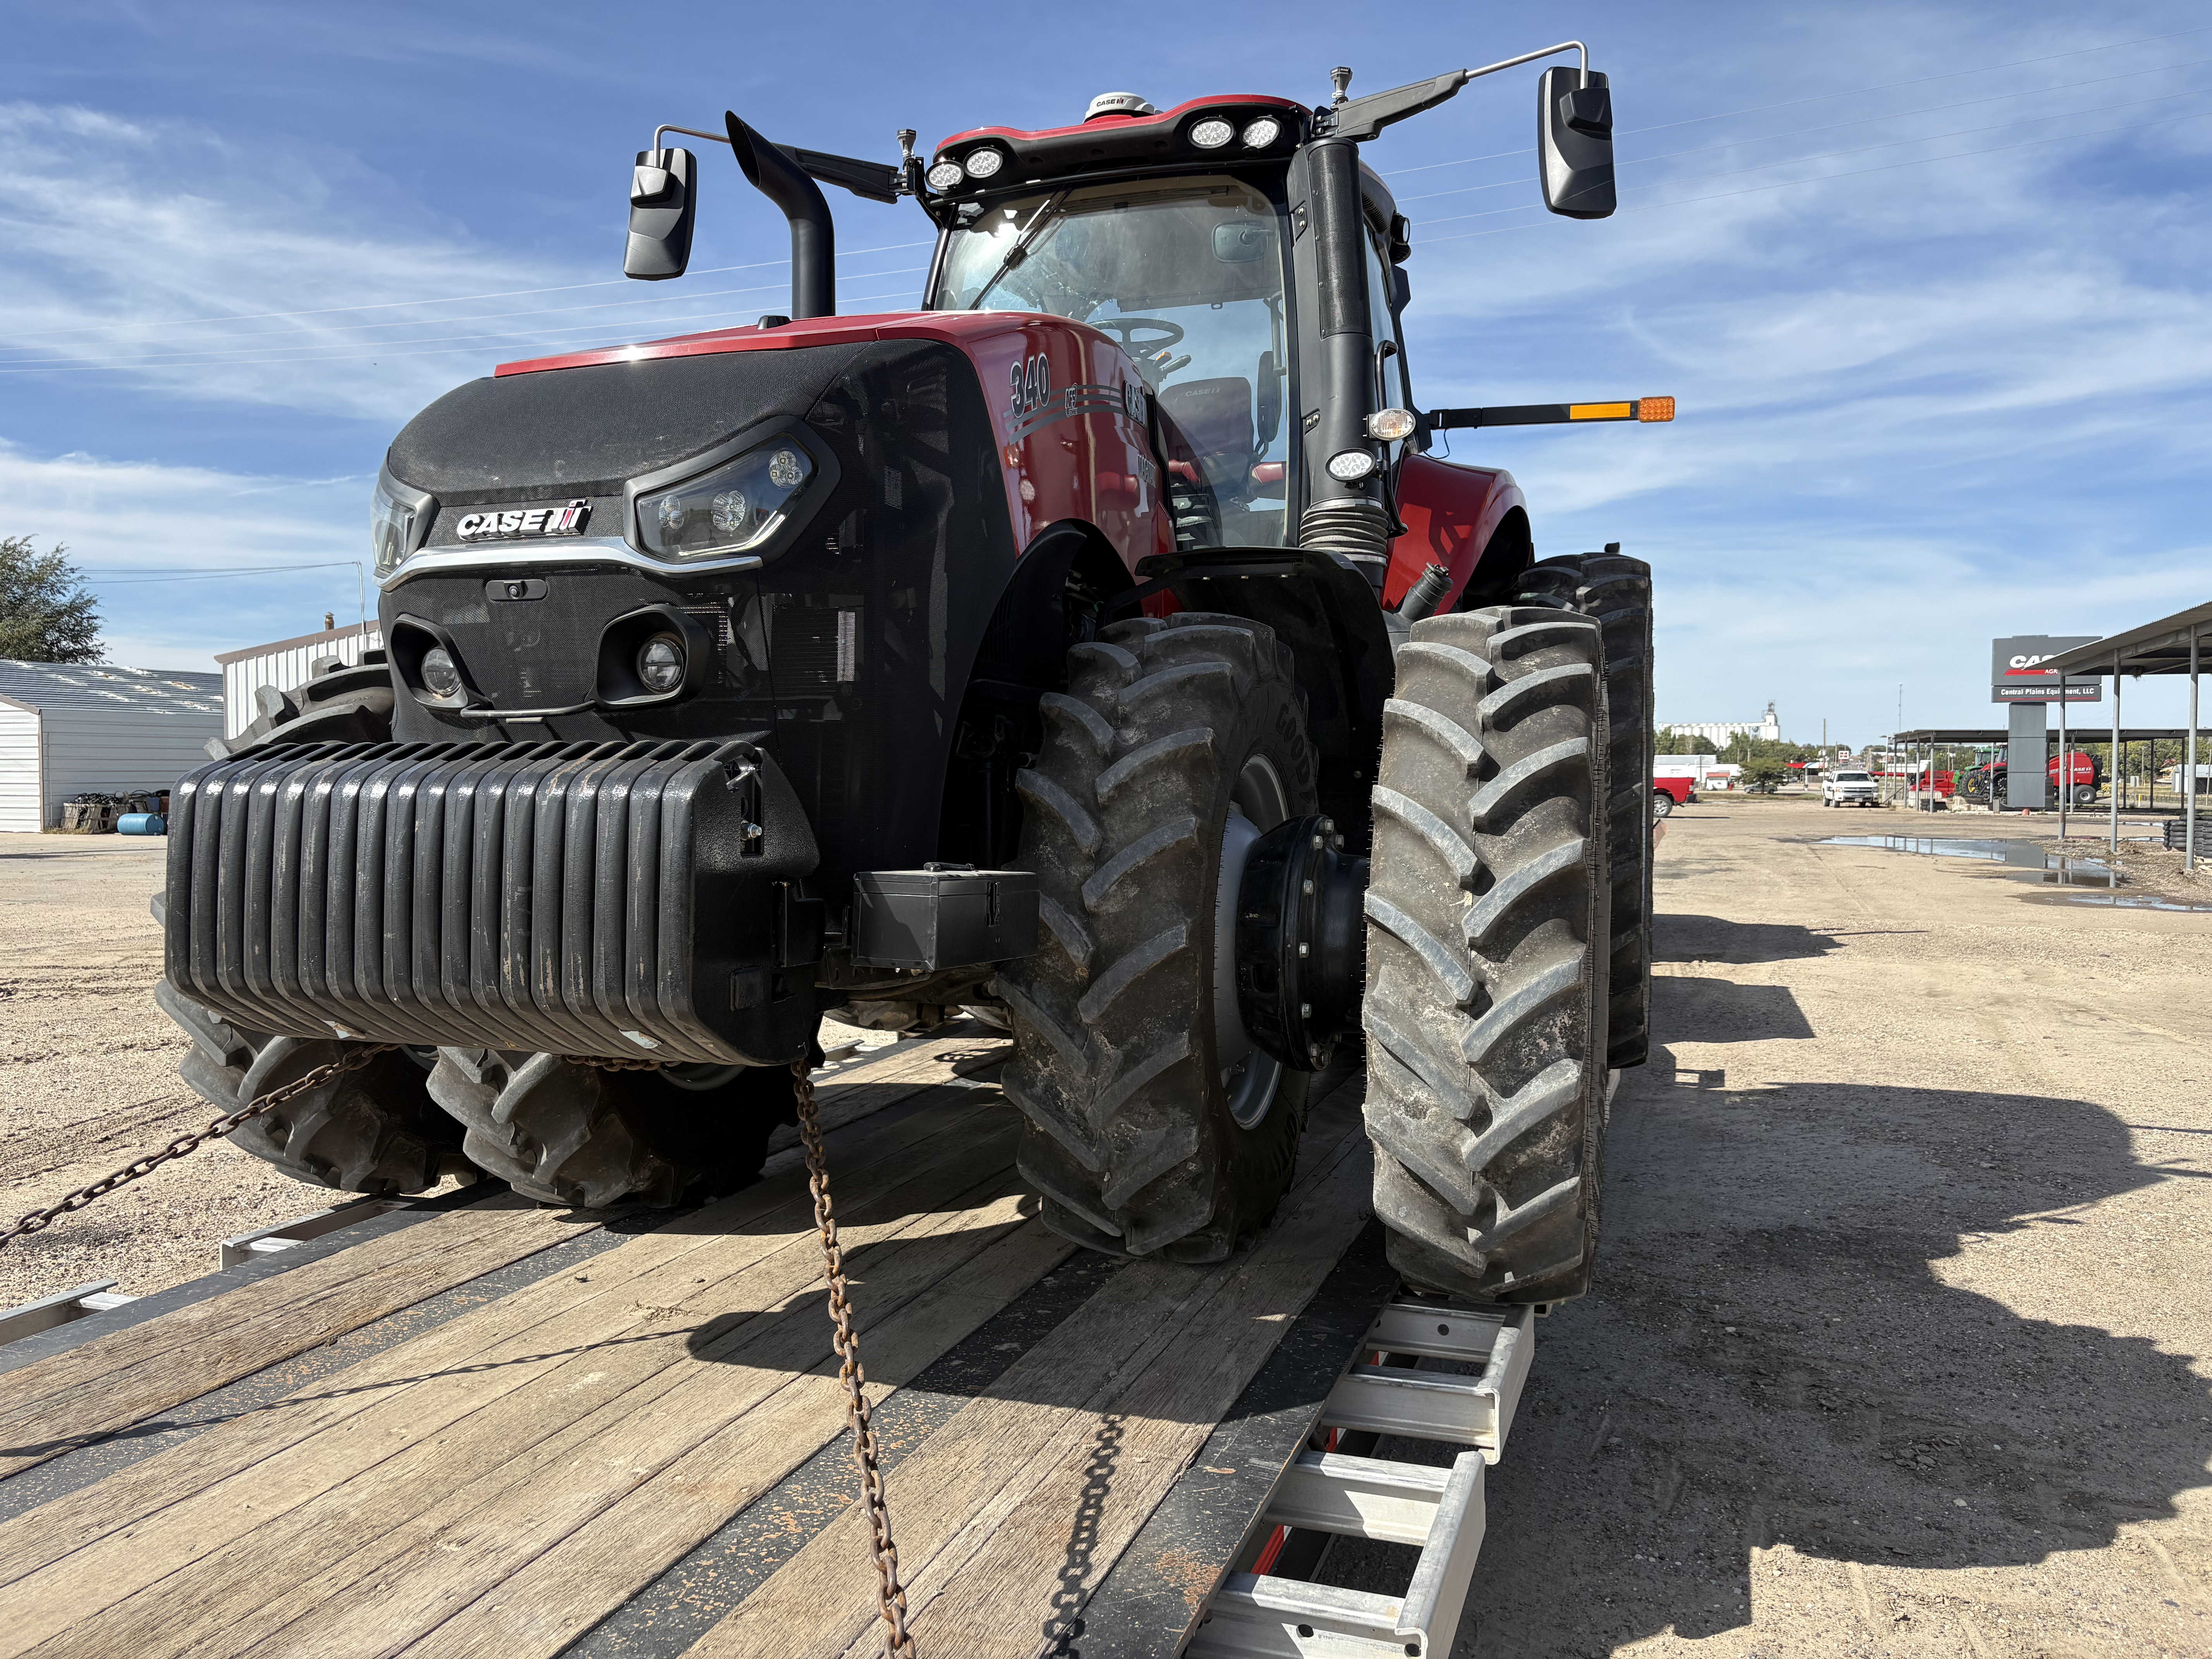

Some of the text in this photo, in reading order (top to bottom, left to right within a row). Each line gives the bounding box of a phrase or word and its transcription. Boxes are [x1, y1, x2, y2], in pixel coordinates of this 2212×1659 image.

[1096, 99, 1116, 107] CASE
[1010, 352, 1050, 419] 340
[1185, 388, 1211, 397] CASE
[457, 510, 546, 536] CASE
